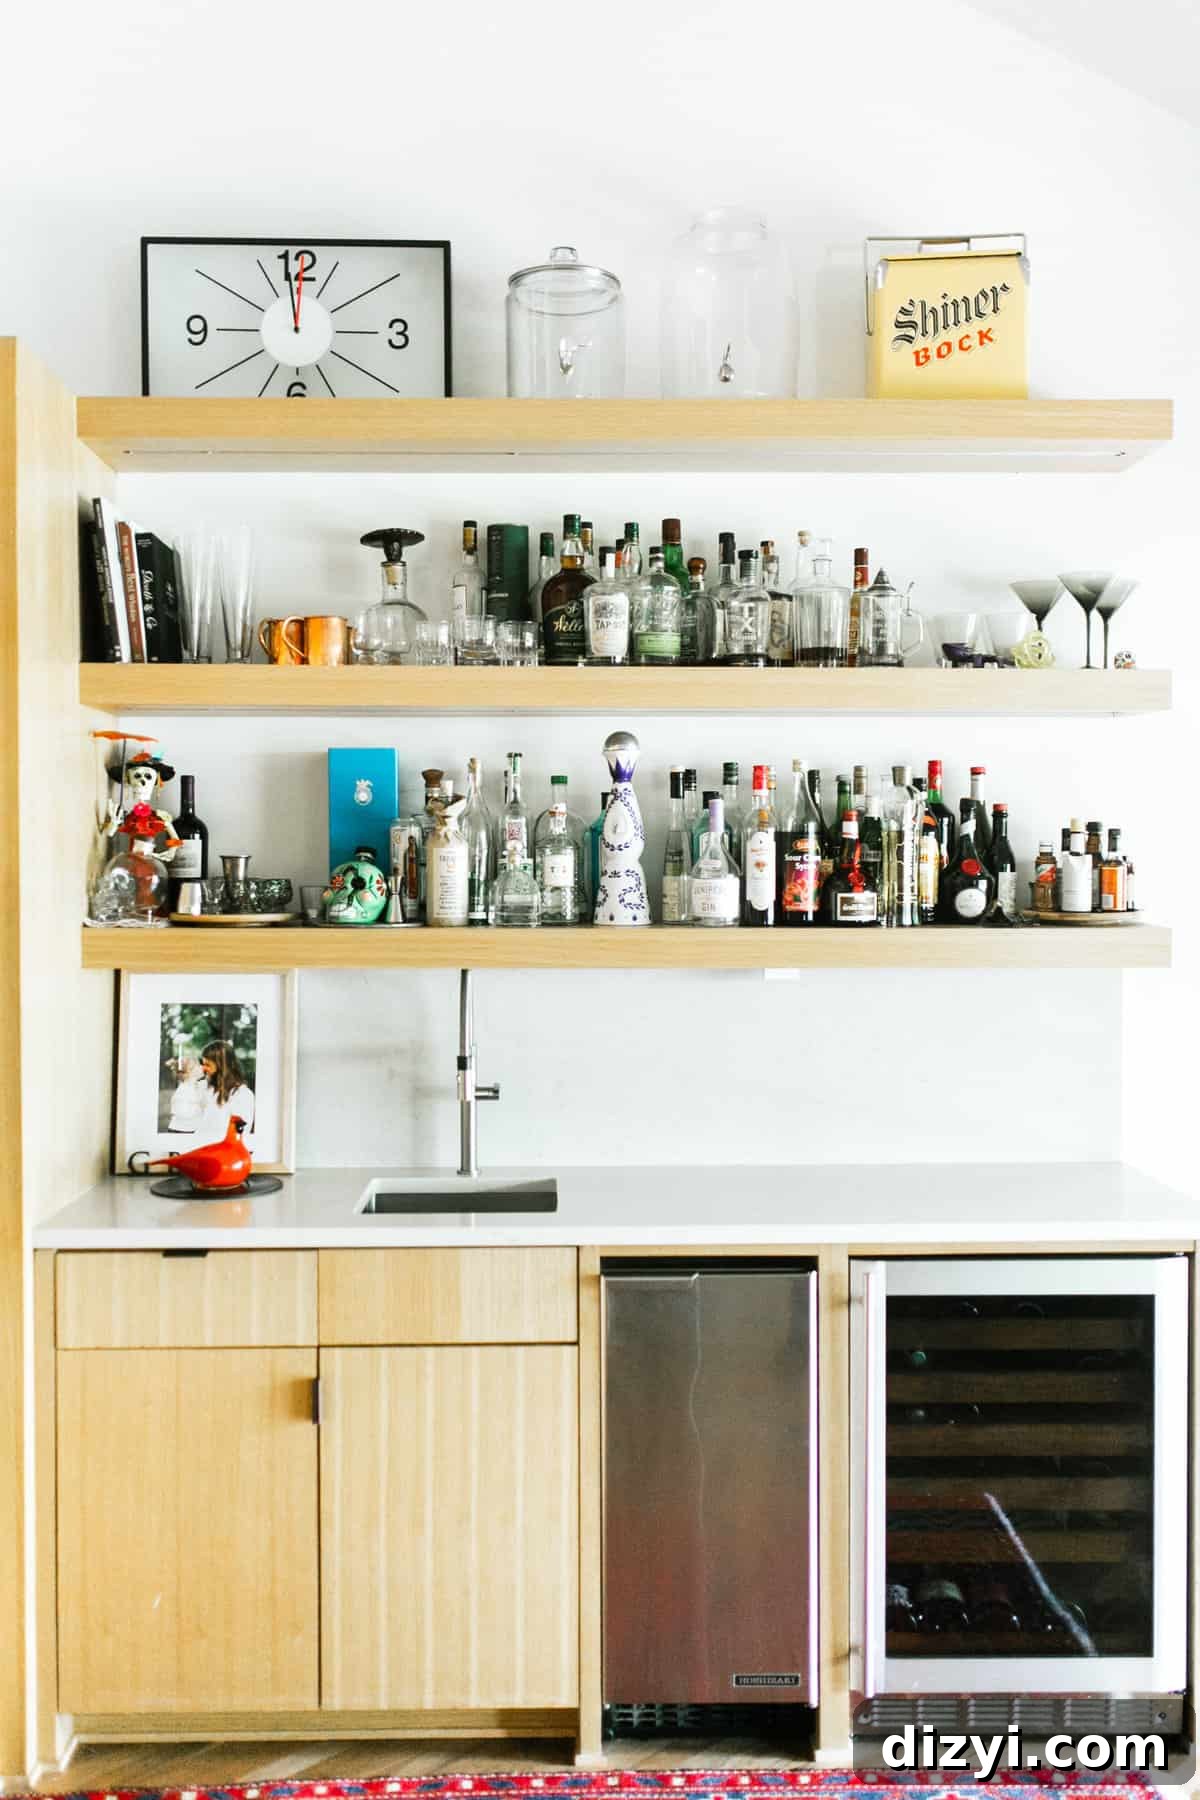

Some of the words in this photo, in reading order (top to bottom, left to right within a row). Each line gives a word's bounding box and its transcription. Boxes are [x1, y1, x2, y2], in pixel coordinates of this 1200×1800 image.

[277, 249, 317, 282] 12
[186, 314, 208, 346] 9
[891, 282, 1010, 348] Shiner
[387, 318, 410, 350] 3
[912, 327, 994, 368] BOCK
